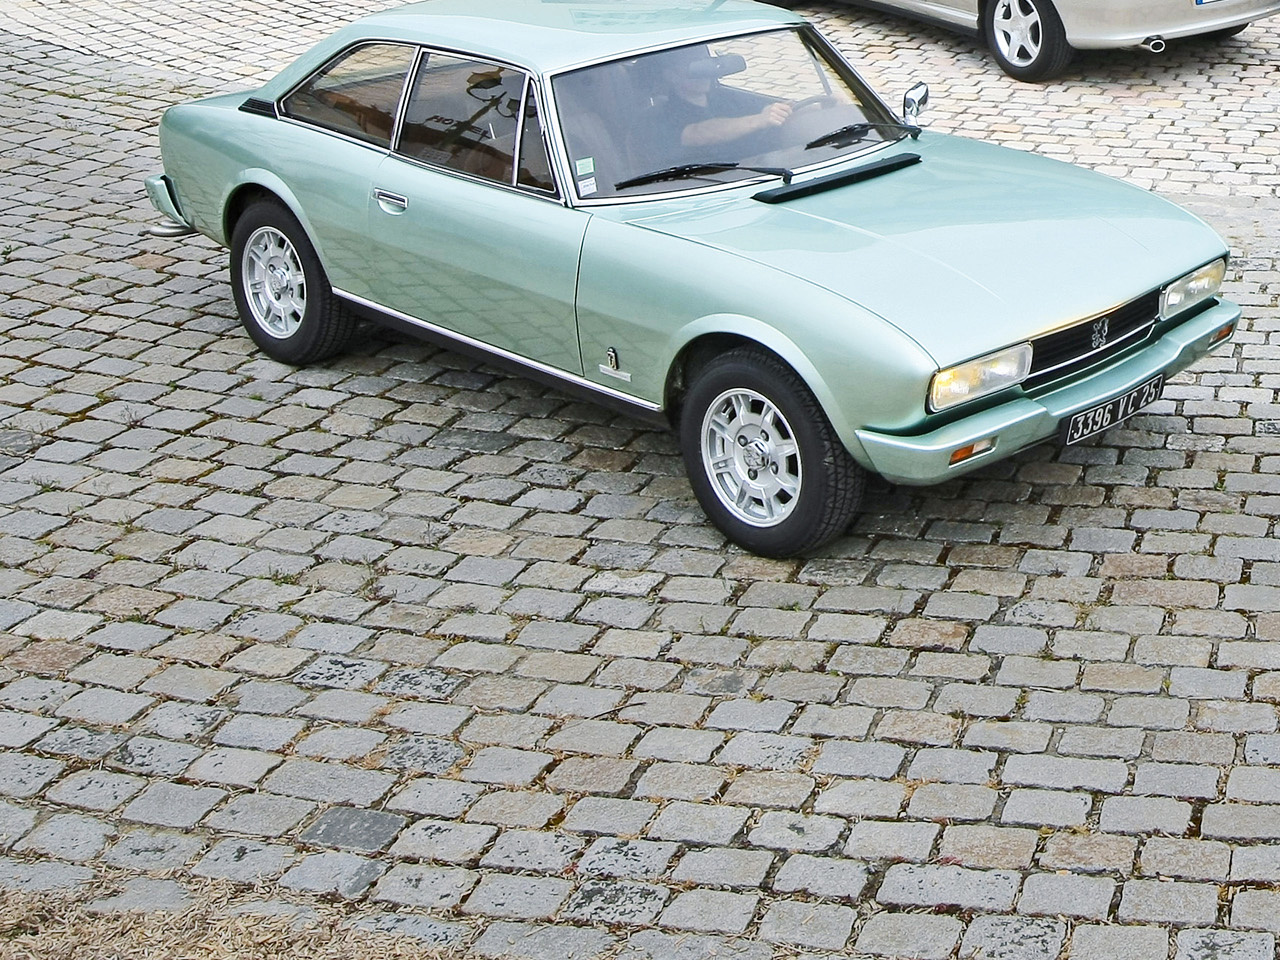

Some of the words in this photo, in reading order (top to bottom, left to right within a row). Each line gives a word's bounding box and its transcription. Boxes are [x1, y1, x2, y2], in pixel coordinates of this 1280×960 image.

[1073, 404, 1113, 439] 3396
[1118, 392, 1137, 420] VC
[1140, 380, 1158, 408] 25
